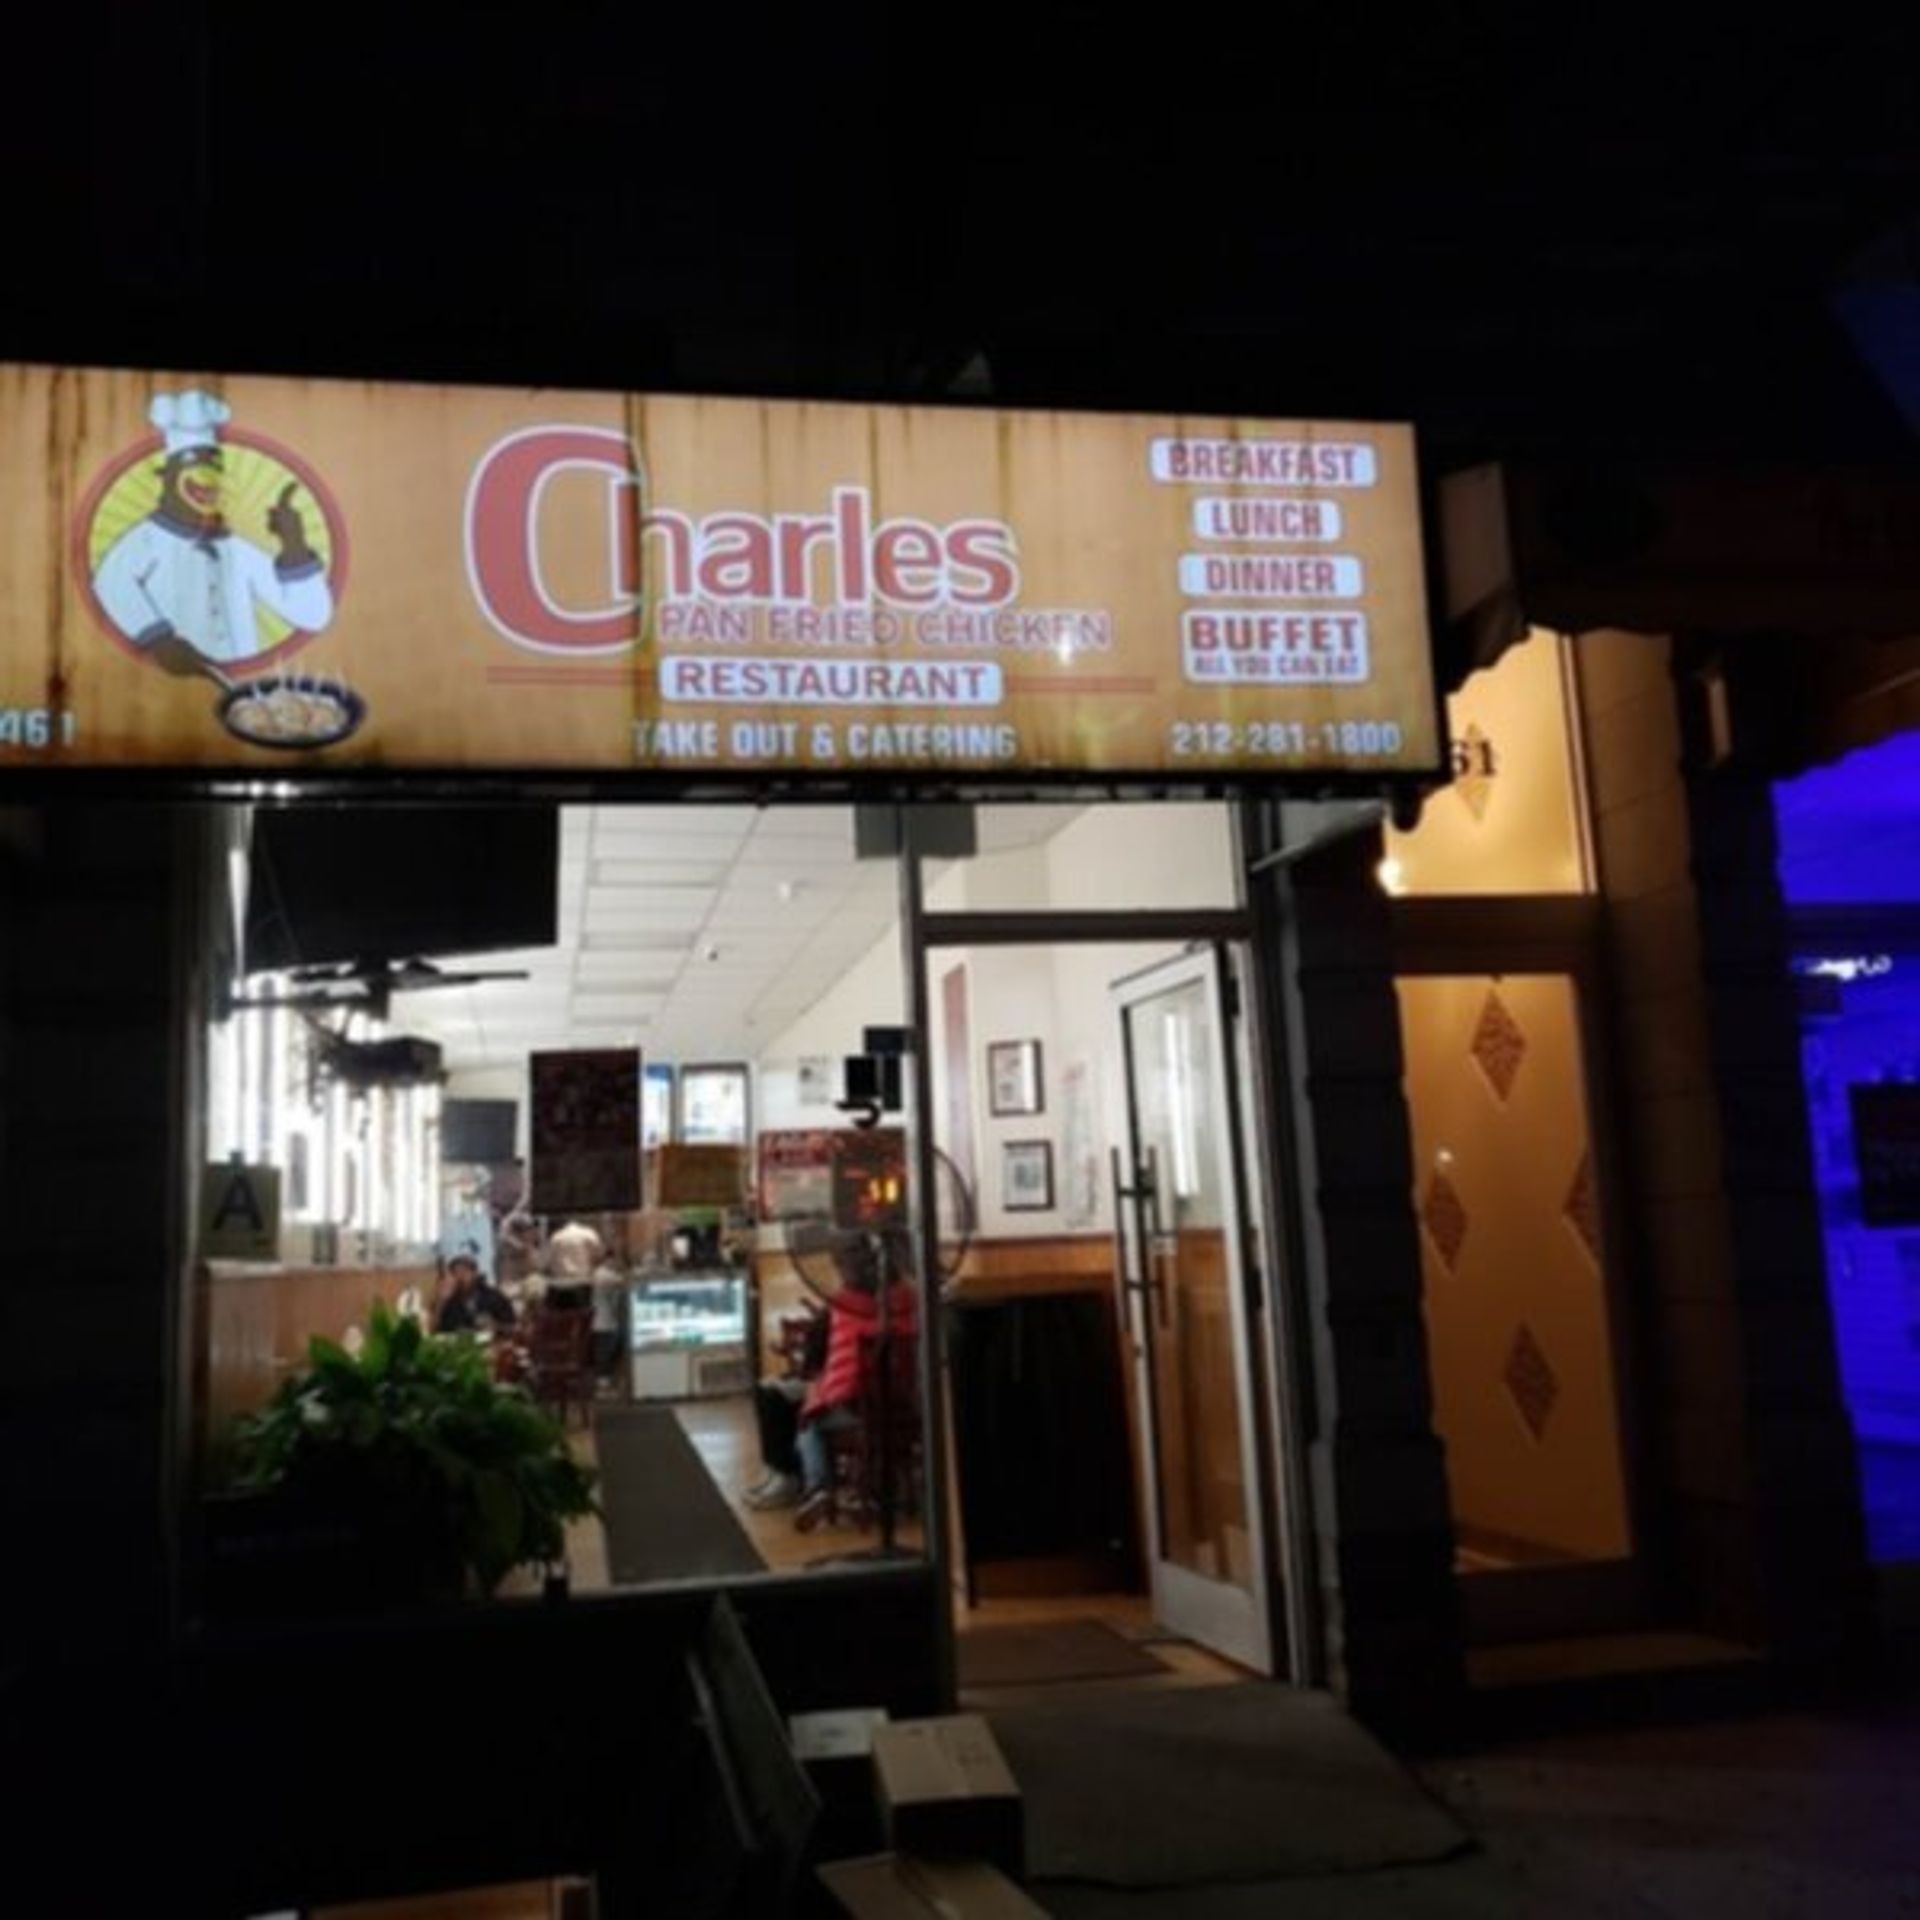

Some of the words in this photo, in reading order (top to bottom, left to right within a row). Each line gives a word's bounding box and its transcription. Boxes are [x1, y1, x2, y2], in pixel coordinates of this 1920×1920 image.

[1168, 443, 1357, 484] BREAKFAST
[464, 424, 1018, 655] Charles
[1211, 504, 1323, 538] LUNCH
[1206, 559, 1337, 593] DINNER
[658, 605, 750, 643] PAN
[768, 608, 900, 645] FRIED
[915, 611, 1112, 648] CHICKEN
[1190, 616, 1360, 652] BUFFET
[675, 662, 988, 699] RESTAURANT
[1233, 656, 1271, 675] YOU
[1278, 656, 1319, 675] CAN
[633, 720, 718, 758] TAKE
[732, 721, 798, 757] OUT
[811, 722, 836, 757] &
[847, 724, 1017, 757] CATERING
[1172, 720, 1401, 754] 212-281-1800
[211, 1175, 264, 1231] A
